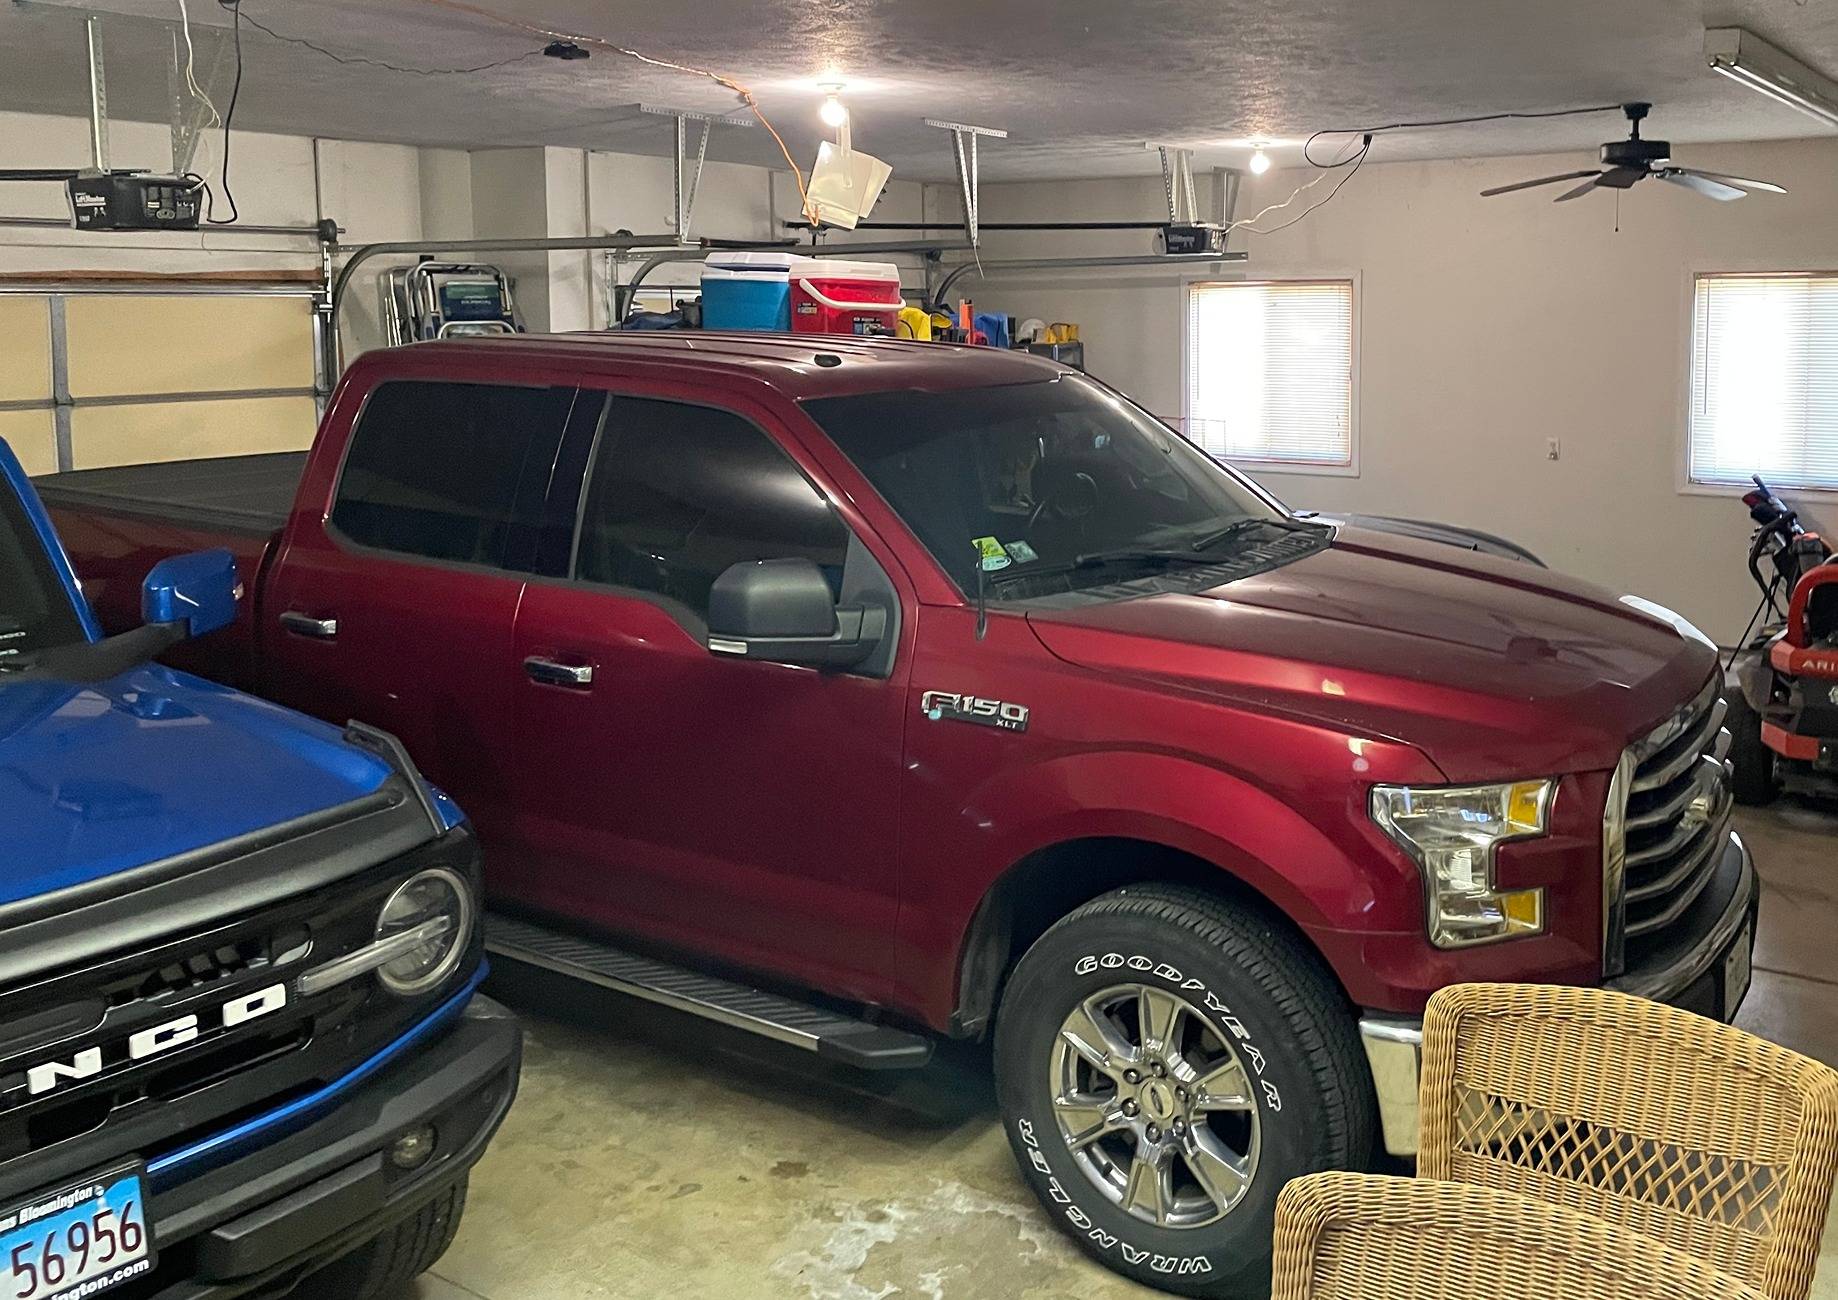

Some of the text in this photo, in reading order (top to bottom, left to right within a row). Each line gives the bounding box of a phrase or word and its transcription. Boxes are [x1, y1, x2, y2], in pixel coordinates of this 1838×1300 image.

[996, 718, 1018, 729] XLT
[27, 982, 286, 1094] NCO
[1075, 953, 1281, 1112] GOODYEAR
[19, 1186, 93, 1225] Bloomington
[1018, 1118, 1212, 1274] WRANGLER
[11, 1200, 142, 1298] 56956
